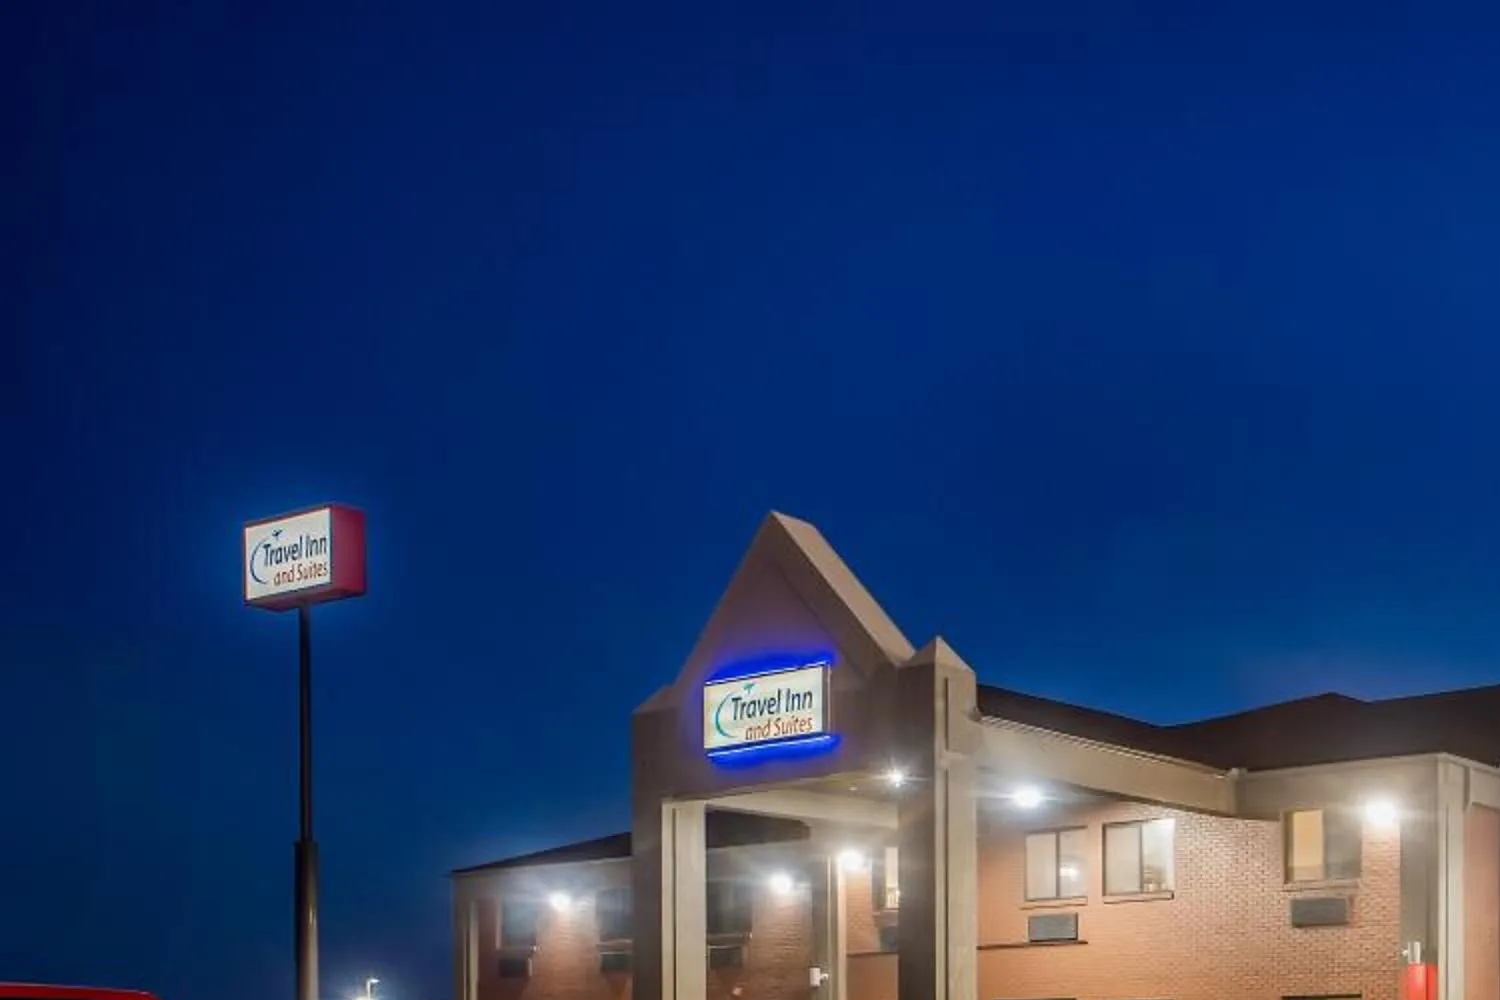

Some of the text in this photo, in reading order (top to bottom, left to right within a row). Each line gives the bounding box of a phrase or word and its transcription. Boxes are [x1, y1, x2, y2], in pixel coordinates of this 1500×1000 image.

[263, 534, 327, 567] Travel Inn
[274, 561, 328, 586] and Suites
[731, 688, 813, 721] Travel Inn
[745, 715, 813, 741] and Suites
